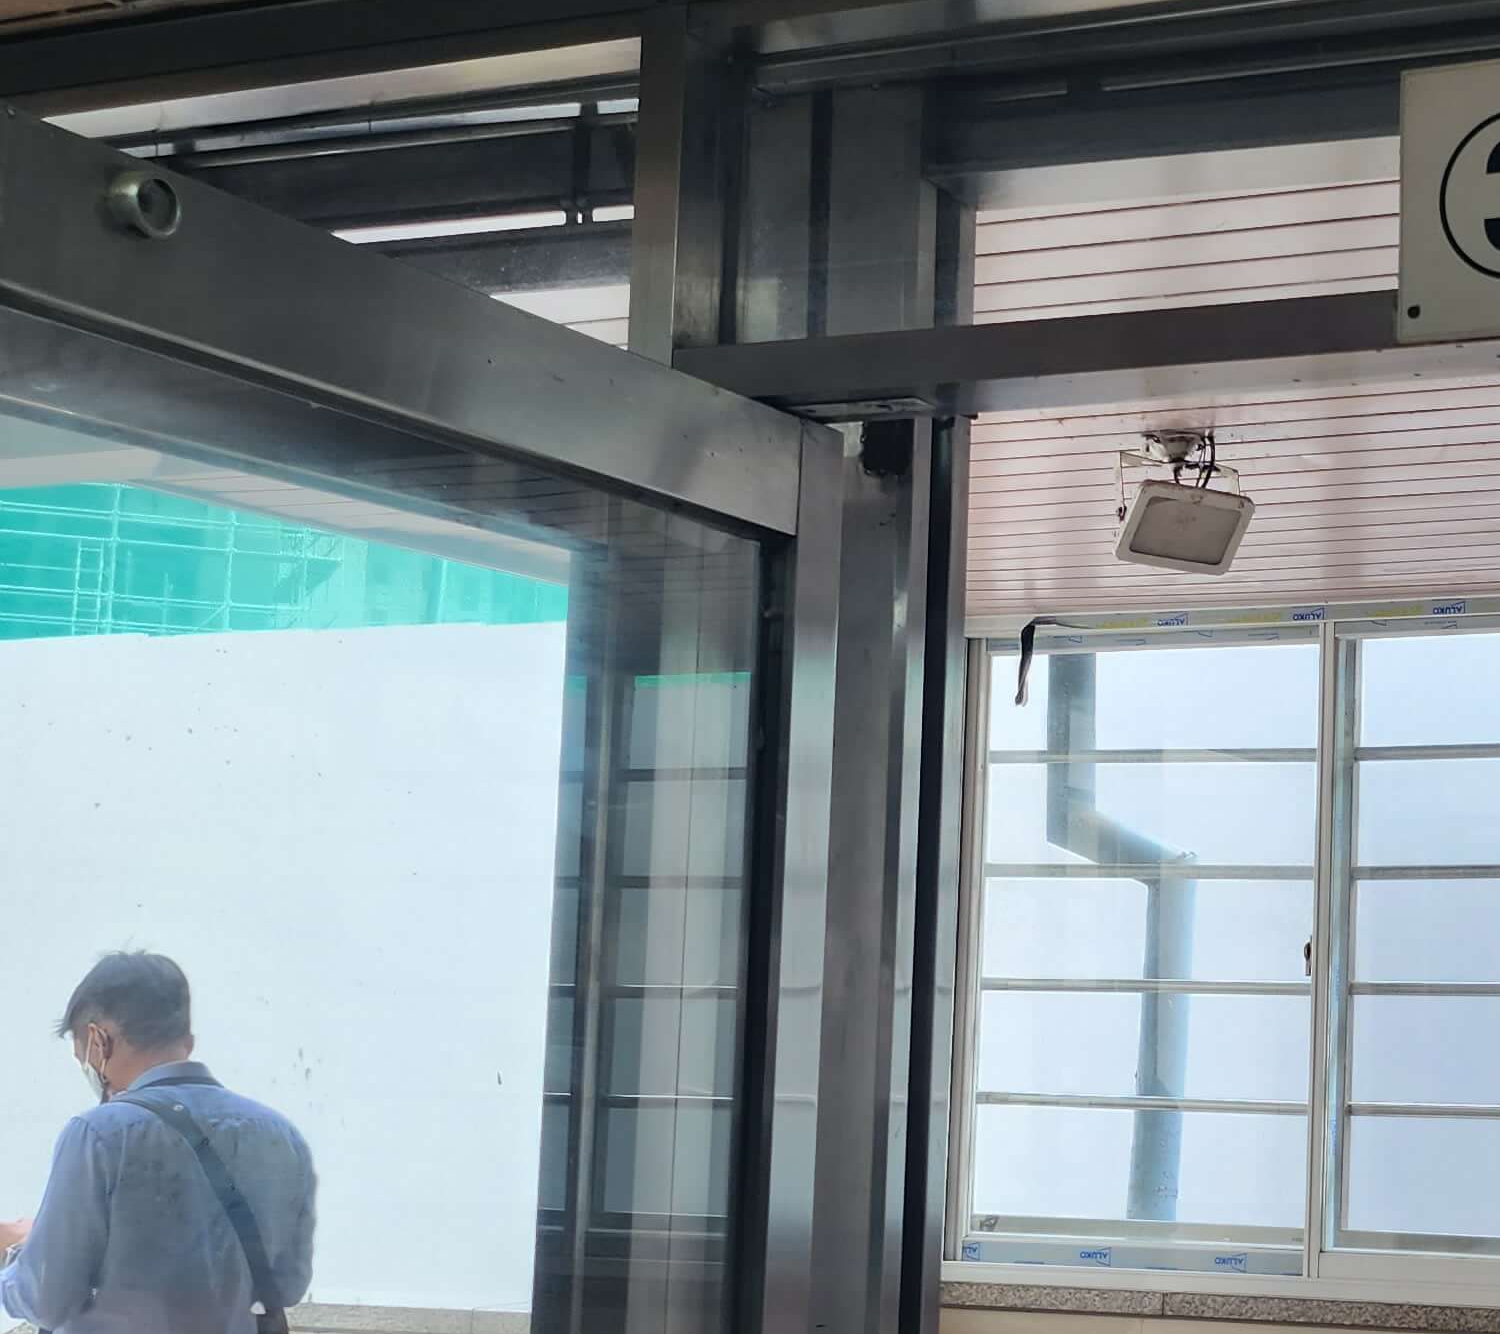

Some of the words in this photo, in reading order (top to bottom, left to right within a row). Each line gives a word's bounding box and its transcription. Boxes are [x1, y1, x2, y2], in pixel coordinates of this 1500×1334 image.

[1433, 605, 1463, 615] ALUKO
[1079, 1251, 1109, 1260] ALUKO
[1215, 1257, 1244, 1265] ALUKO
